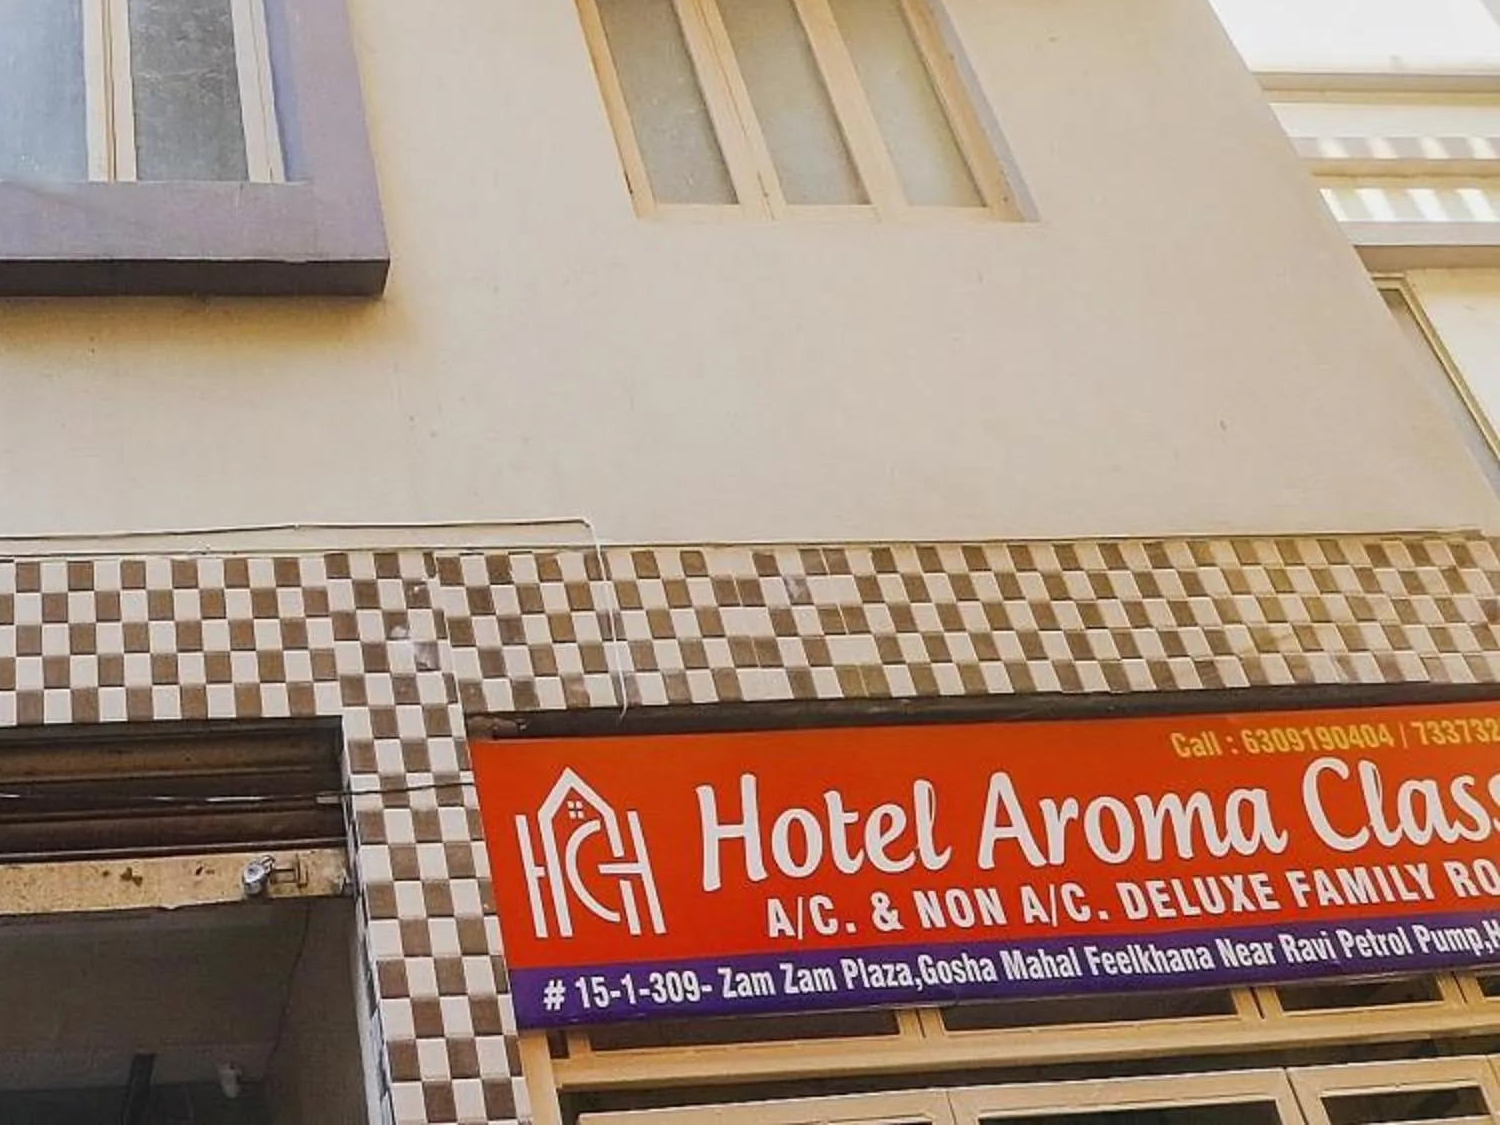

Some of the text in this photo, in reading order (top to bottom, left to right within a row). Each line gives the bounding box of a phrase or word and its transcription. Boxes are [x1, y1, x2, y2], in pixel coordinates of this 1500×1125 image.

[1170, 732, 1222, 758] Call
[1240, 723, 1395, 755] 6309190404
[695, 772, 952, 892] Hotel
[977, 771, 1288, 870] Aroma
[766, 894, 857, 940] A/C.
[870, 891, 904, 932] &
[913, 886, 1007, 929] NON
[1019, 880, 1110, 928] A/C.
[1115, 871, 1281, 921] DELUXE
[1285, 861, 1436, 908] FAMILY
[543, 980, 567, 1011] #
[575, 970, 713, 1010] 15-1-309-
[716, 966, 776, 1000] Zam
[779, 961, 837, 994] Zam
[999, 945, 1084, 981] Mahal
[1084, 941, 1215, 976] Feelkhana
[1215, 936, 1277, 969] Near
[1277, 930, 1336, 964] Ravi
[1335, 925, 1414, 959] Petrol
